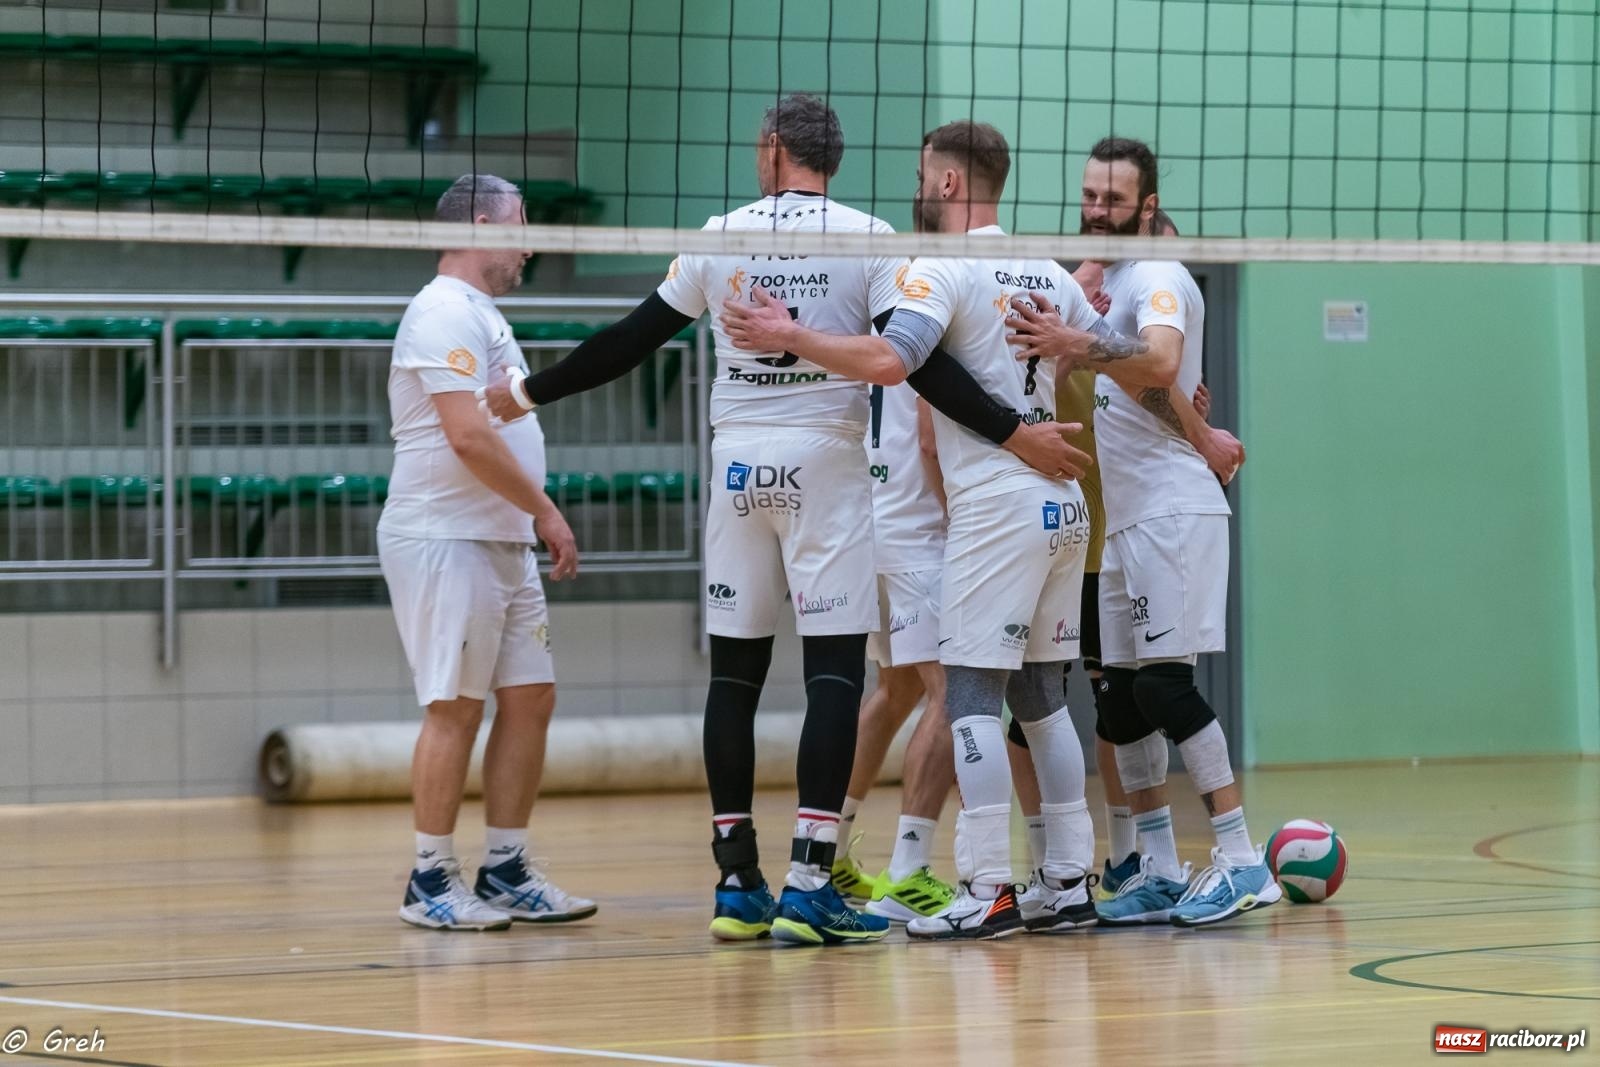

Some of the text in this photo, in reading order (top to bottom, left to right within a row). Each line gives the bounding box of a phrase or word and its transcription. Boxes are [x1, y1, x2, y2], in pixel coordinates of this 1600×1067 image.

[750, 273, 829, 289] ZOO-MAR
[995, 271, 1055, 291] GRUSZKA
[750, 287, 829, 302] LNATYCY
[756, 465, 802, 490] DK
[733, 487, 802, 517] glass
[1063, 500, 1089, 525] DK
[805, 591, 848, 611] kolgraf
[1131, 596, 1148, 609] OO
[1131, 609, 1149, 622] AR
